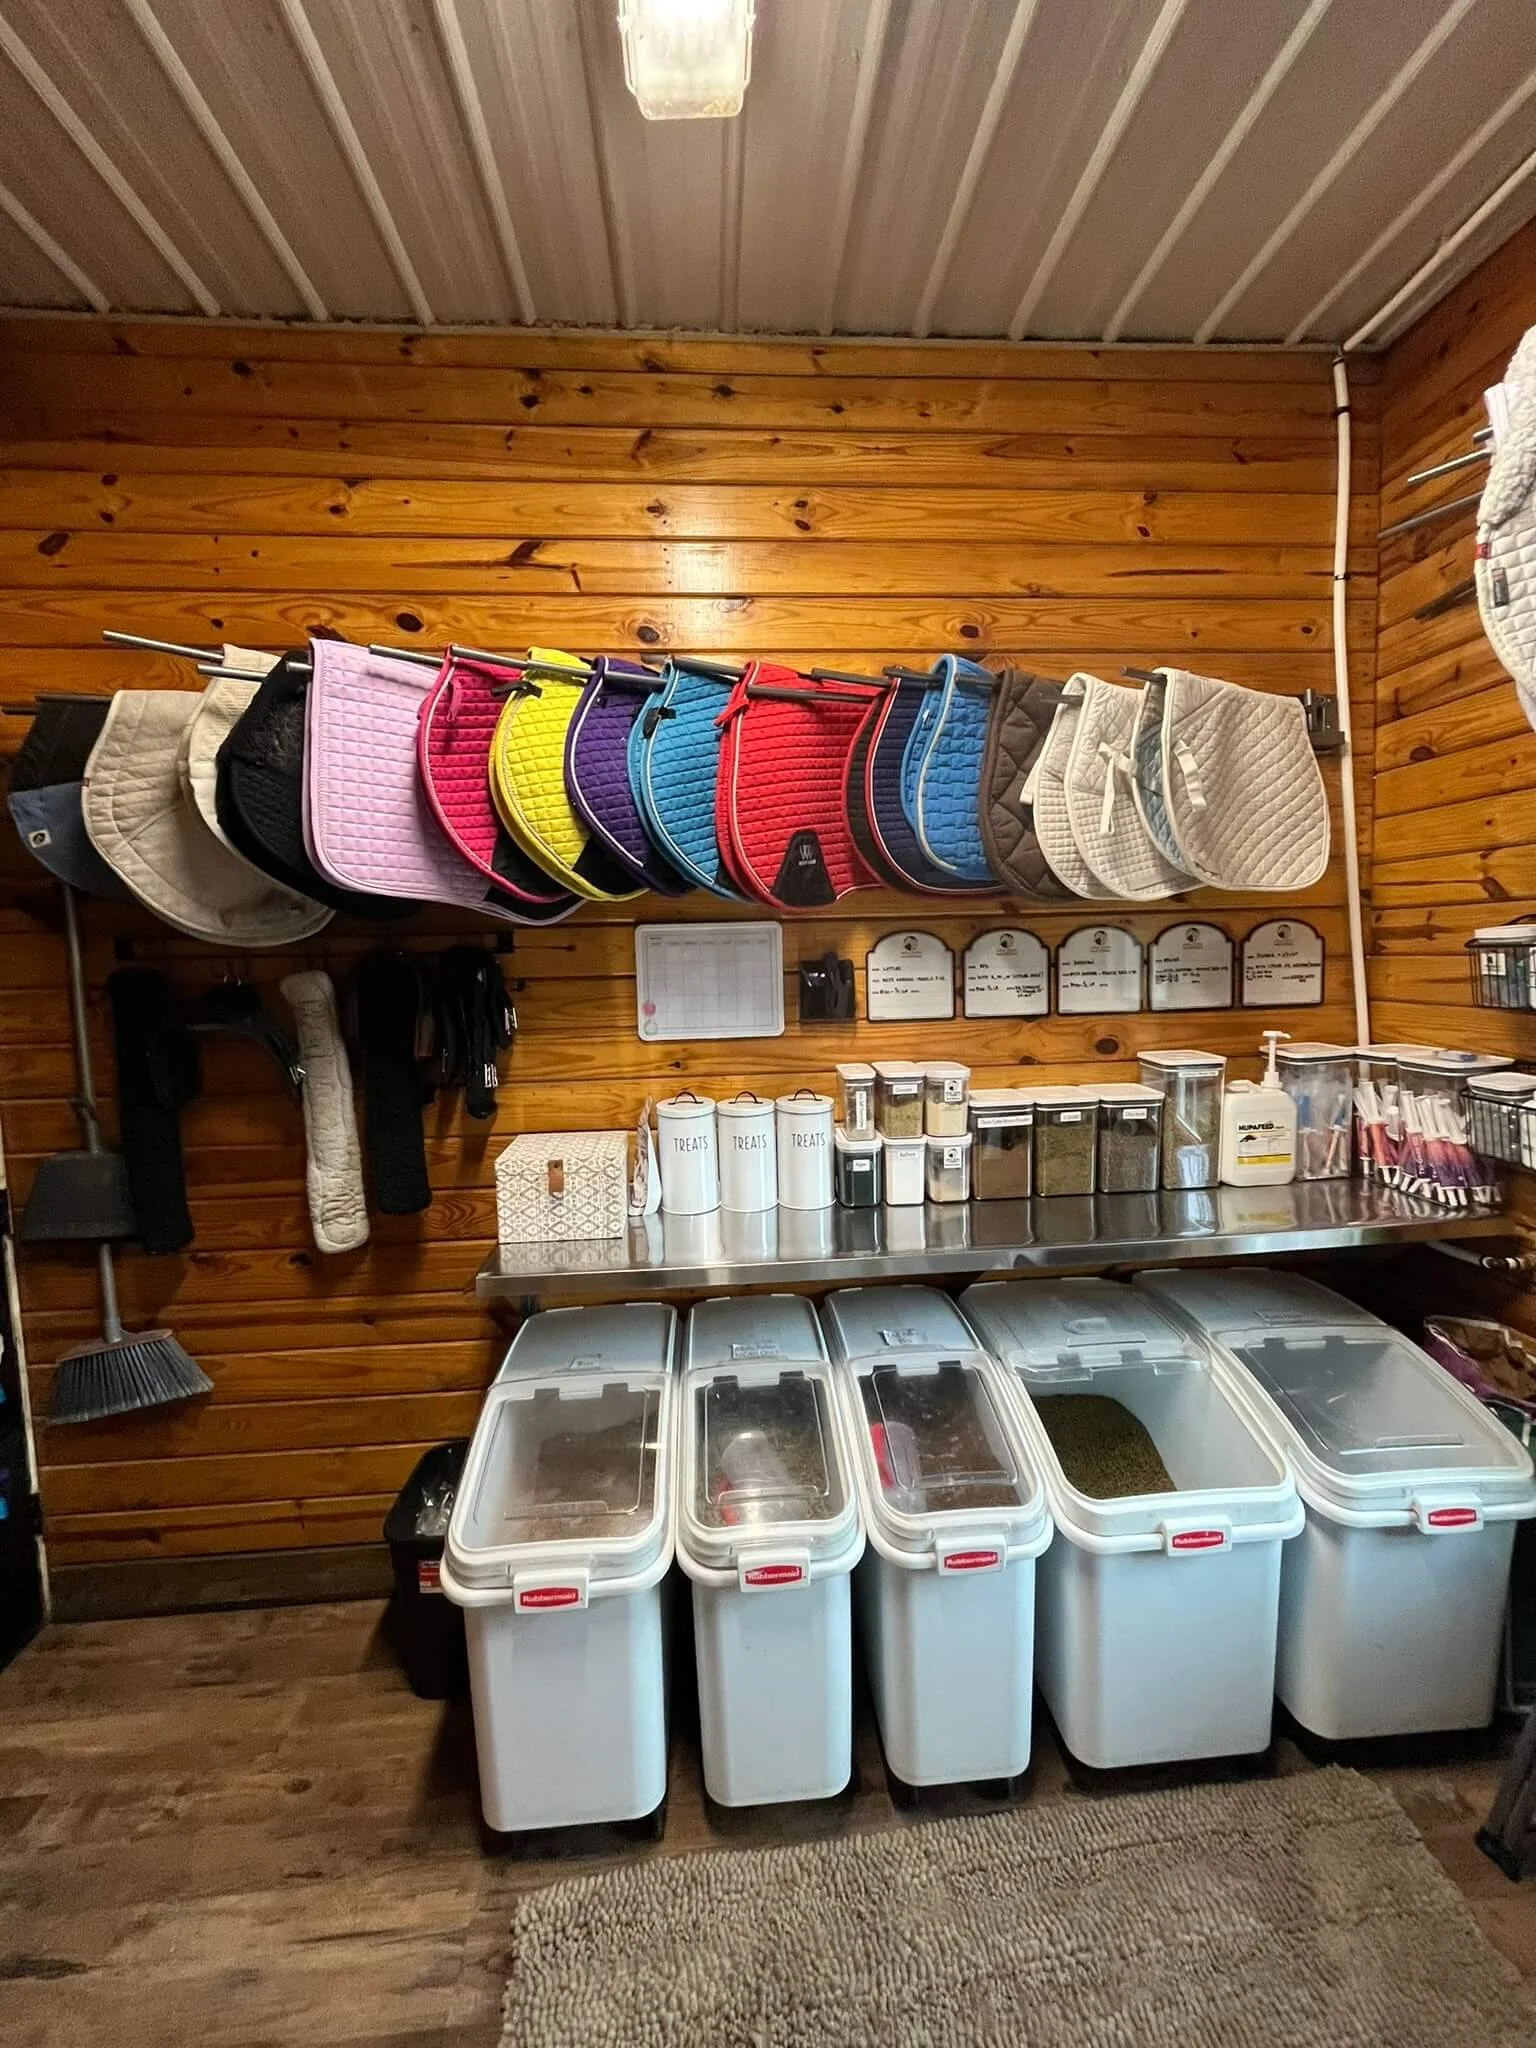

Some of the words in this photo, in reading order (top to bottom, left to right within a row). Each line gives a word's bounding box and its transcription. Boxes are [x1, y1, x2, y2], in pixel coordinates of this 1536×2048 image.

[674, 1135, 708, 1152] TREATS
[733, 1134, 767, 1150] TREATS
[792, 1132, 826, 1148] TREATS
[522, 1592, 576, 1603] Rubbermaid
